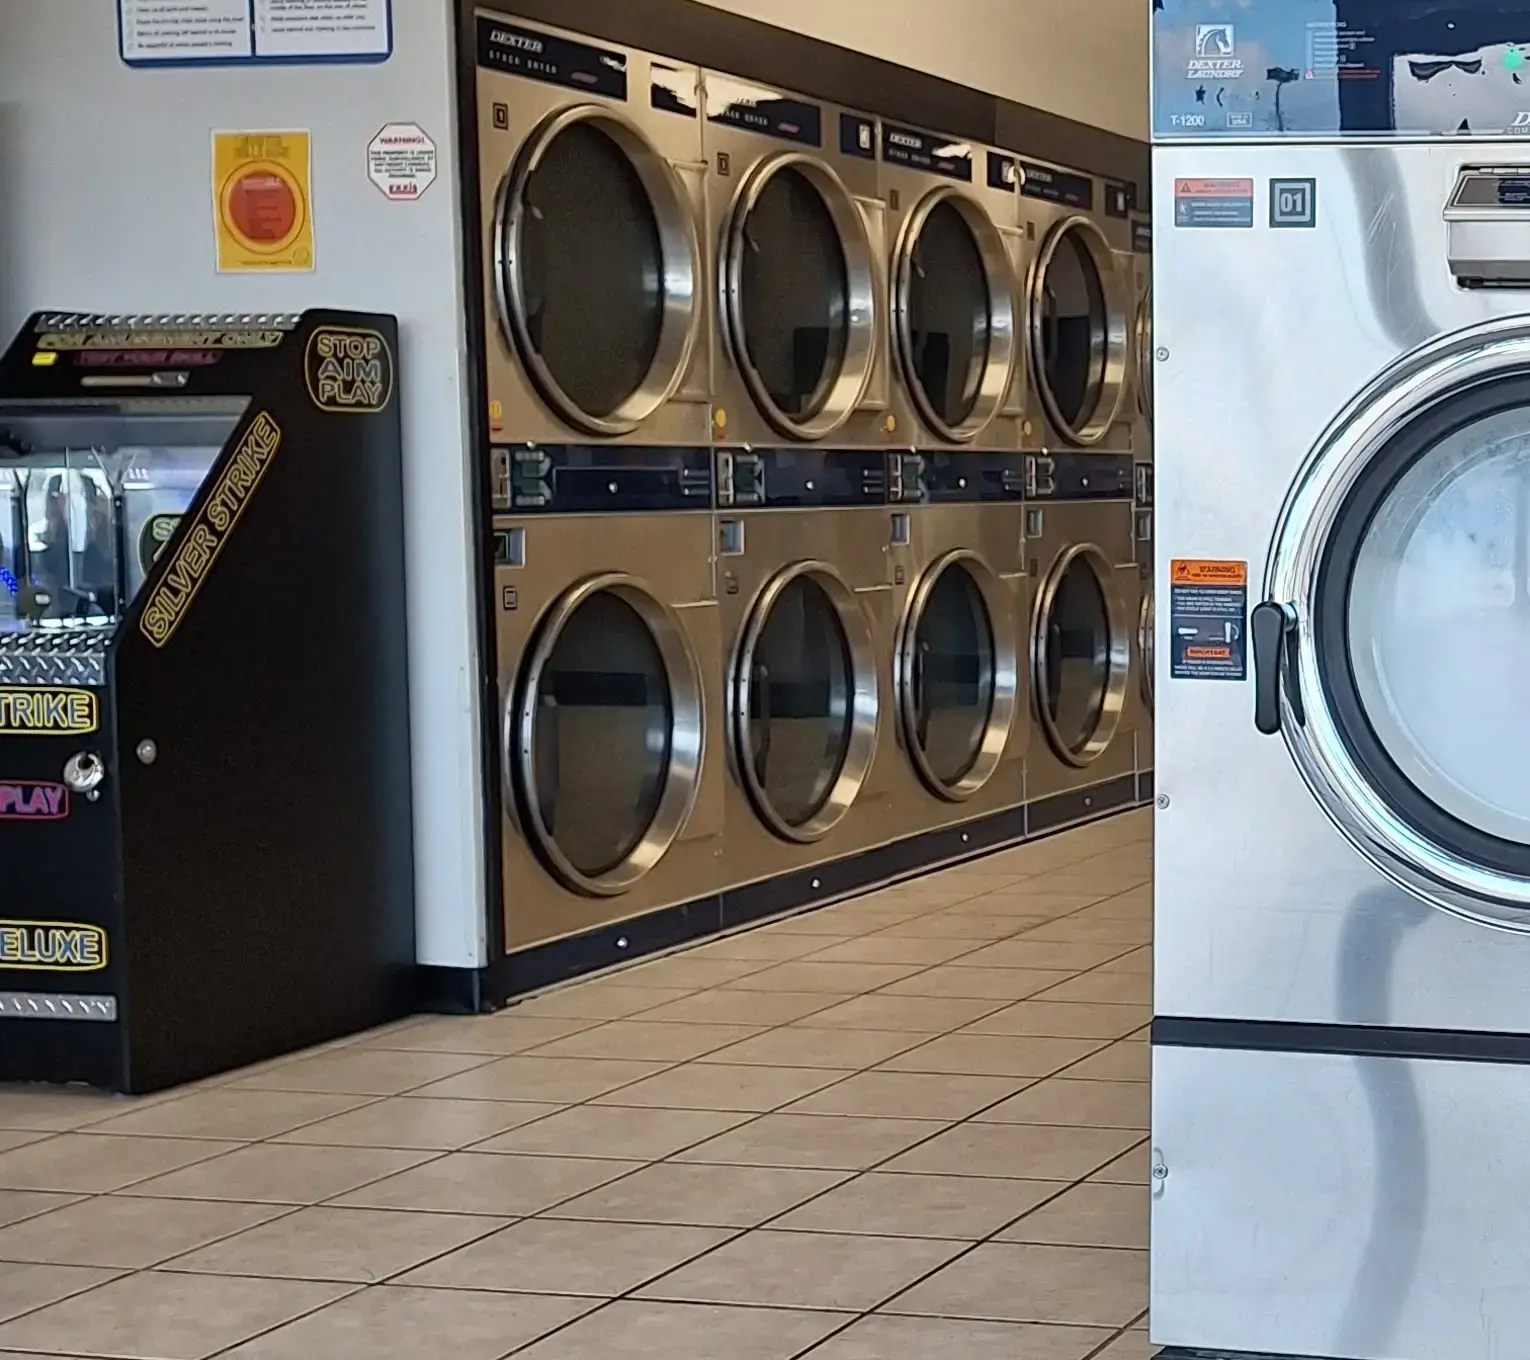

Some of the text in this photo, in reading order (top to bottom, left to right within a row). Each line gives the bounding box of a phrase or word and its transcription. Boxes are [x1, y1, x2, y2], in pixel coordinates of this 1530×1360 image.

[489, 29, 544, 54] DEXTER
[1186, 59, 1242, 69] DEXTER
[1186, 69, 1244, 79] LAUNDRY
[1170, 113, 1205, 127] T-1200
[889, 133, 922, 149] DEXTER
[1280, 192, 1303, 213] 01
[317, 335, 381, 359] STOP
[317, 358, 381, 382] AIM
[319, 381, 382, 404] PLAY
[144, 416, 278, 640] SILVER STRIKE
[0, 785, 63, 816] PLAY
